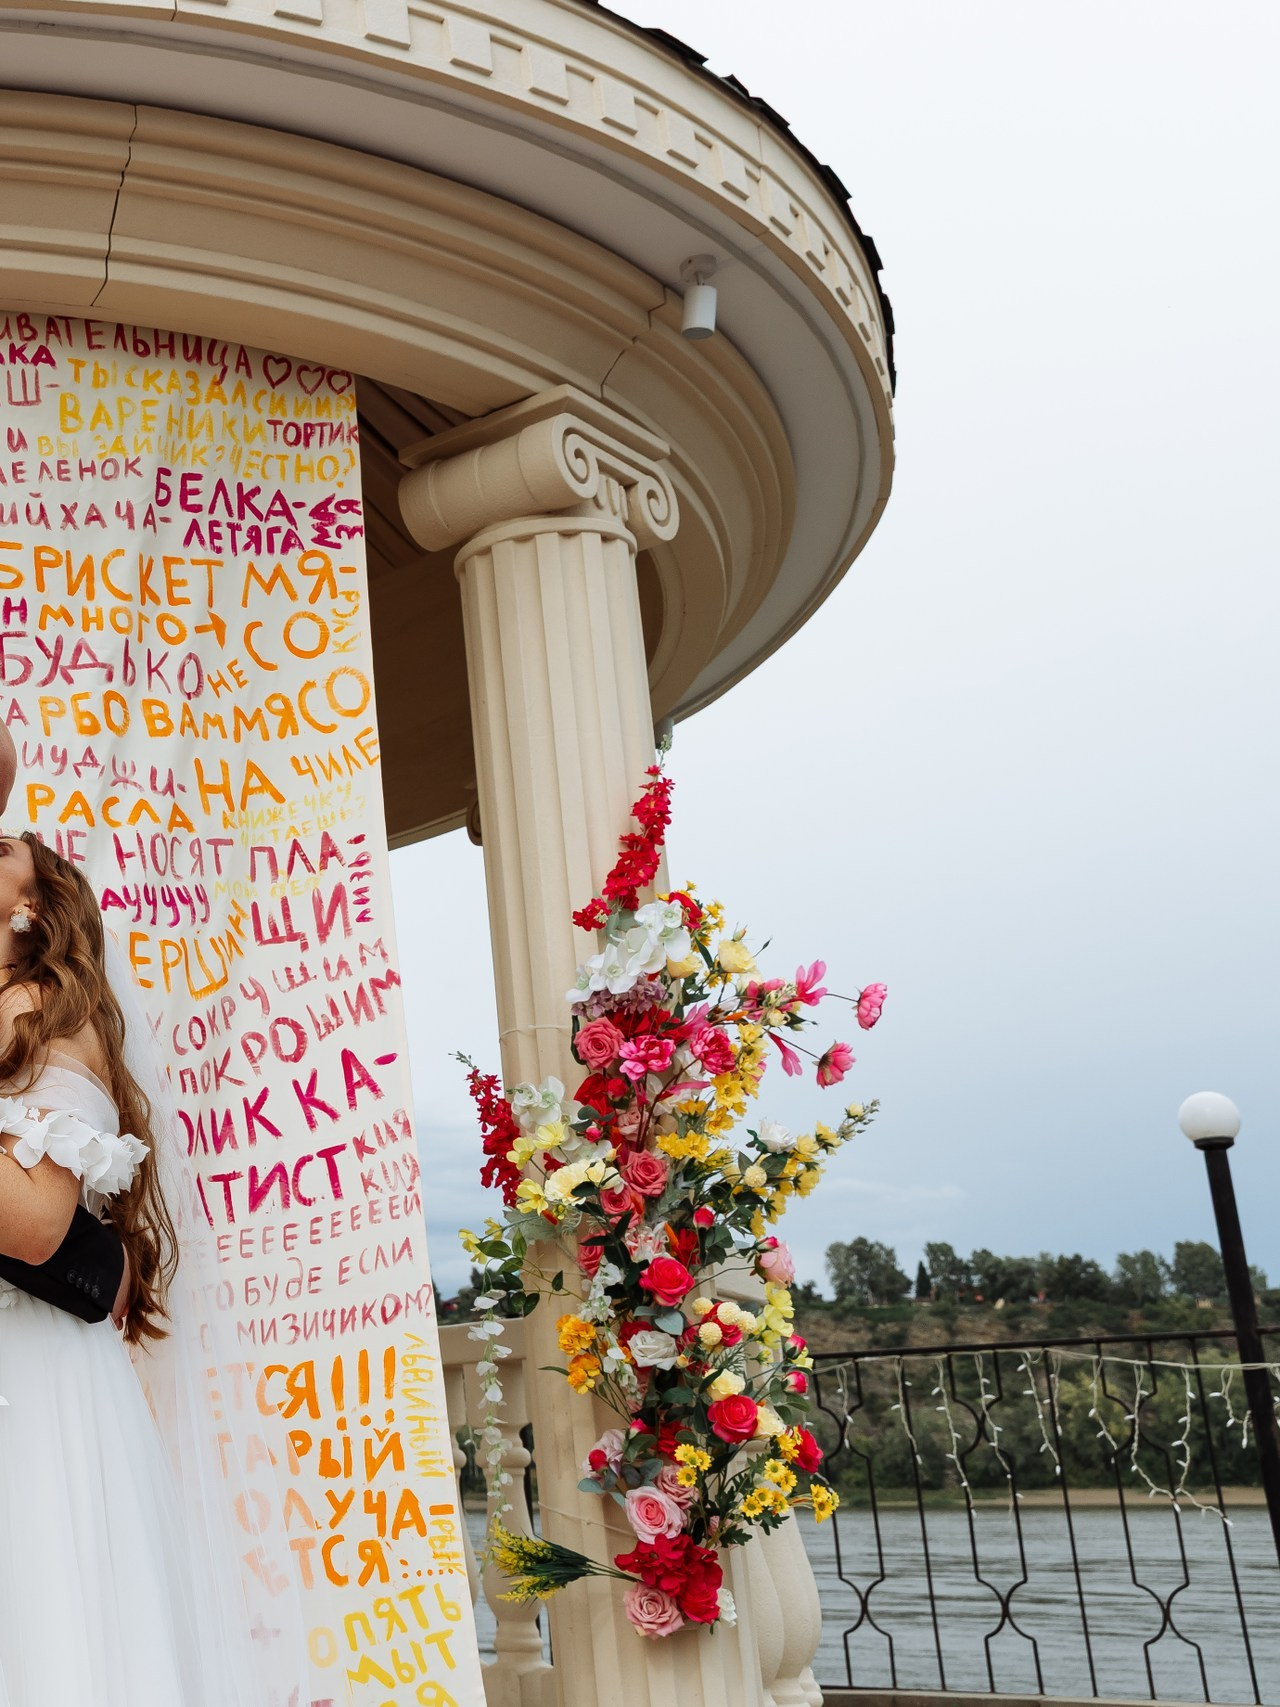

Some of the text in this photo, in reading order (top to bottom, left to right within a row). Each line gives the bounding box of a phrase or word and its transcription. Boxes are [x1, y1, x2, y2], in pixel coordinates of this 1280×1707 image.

[59, 392, 268, 446] ВАРЕНИКИ
[266, 418, 360, 451] ТОРТИК
[155, 467, 307, 531] БЕЛКА-
[183, 518, 307, 557] ЛЕТЯГА
[38, 604, 188, 646] МНОГО
[207, 658, 250, 699] НЕ
[112, 829, 234, 880] НОСЯТ
[338, 1236, 414, 1286] ЕСЛИ
